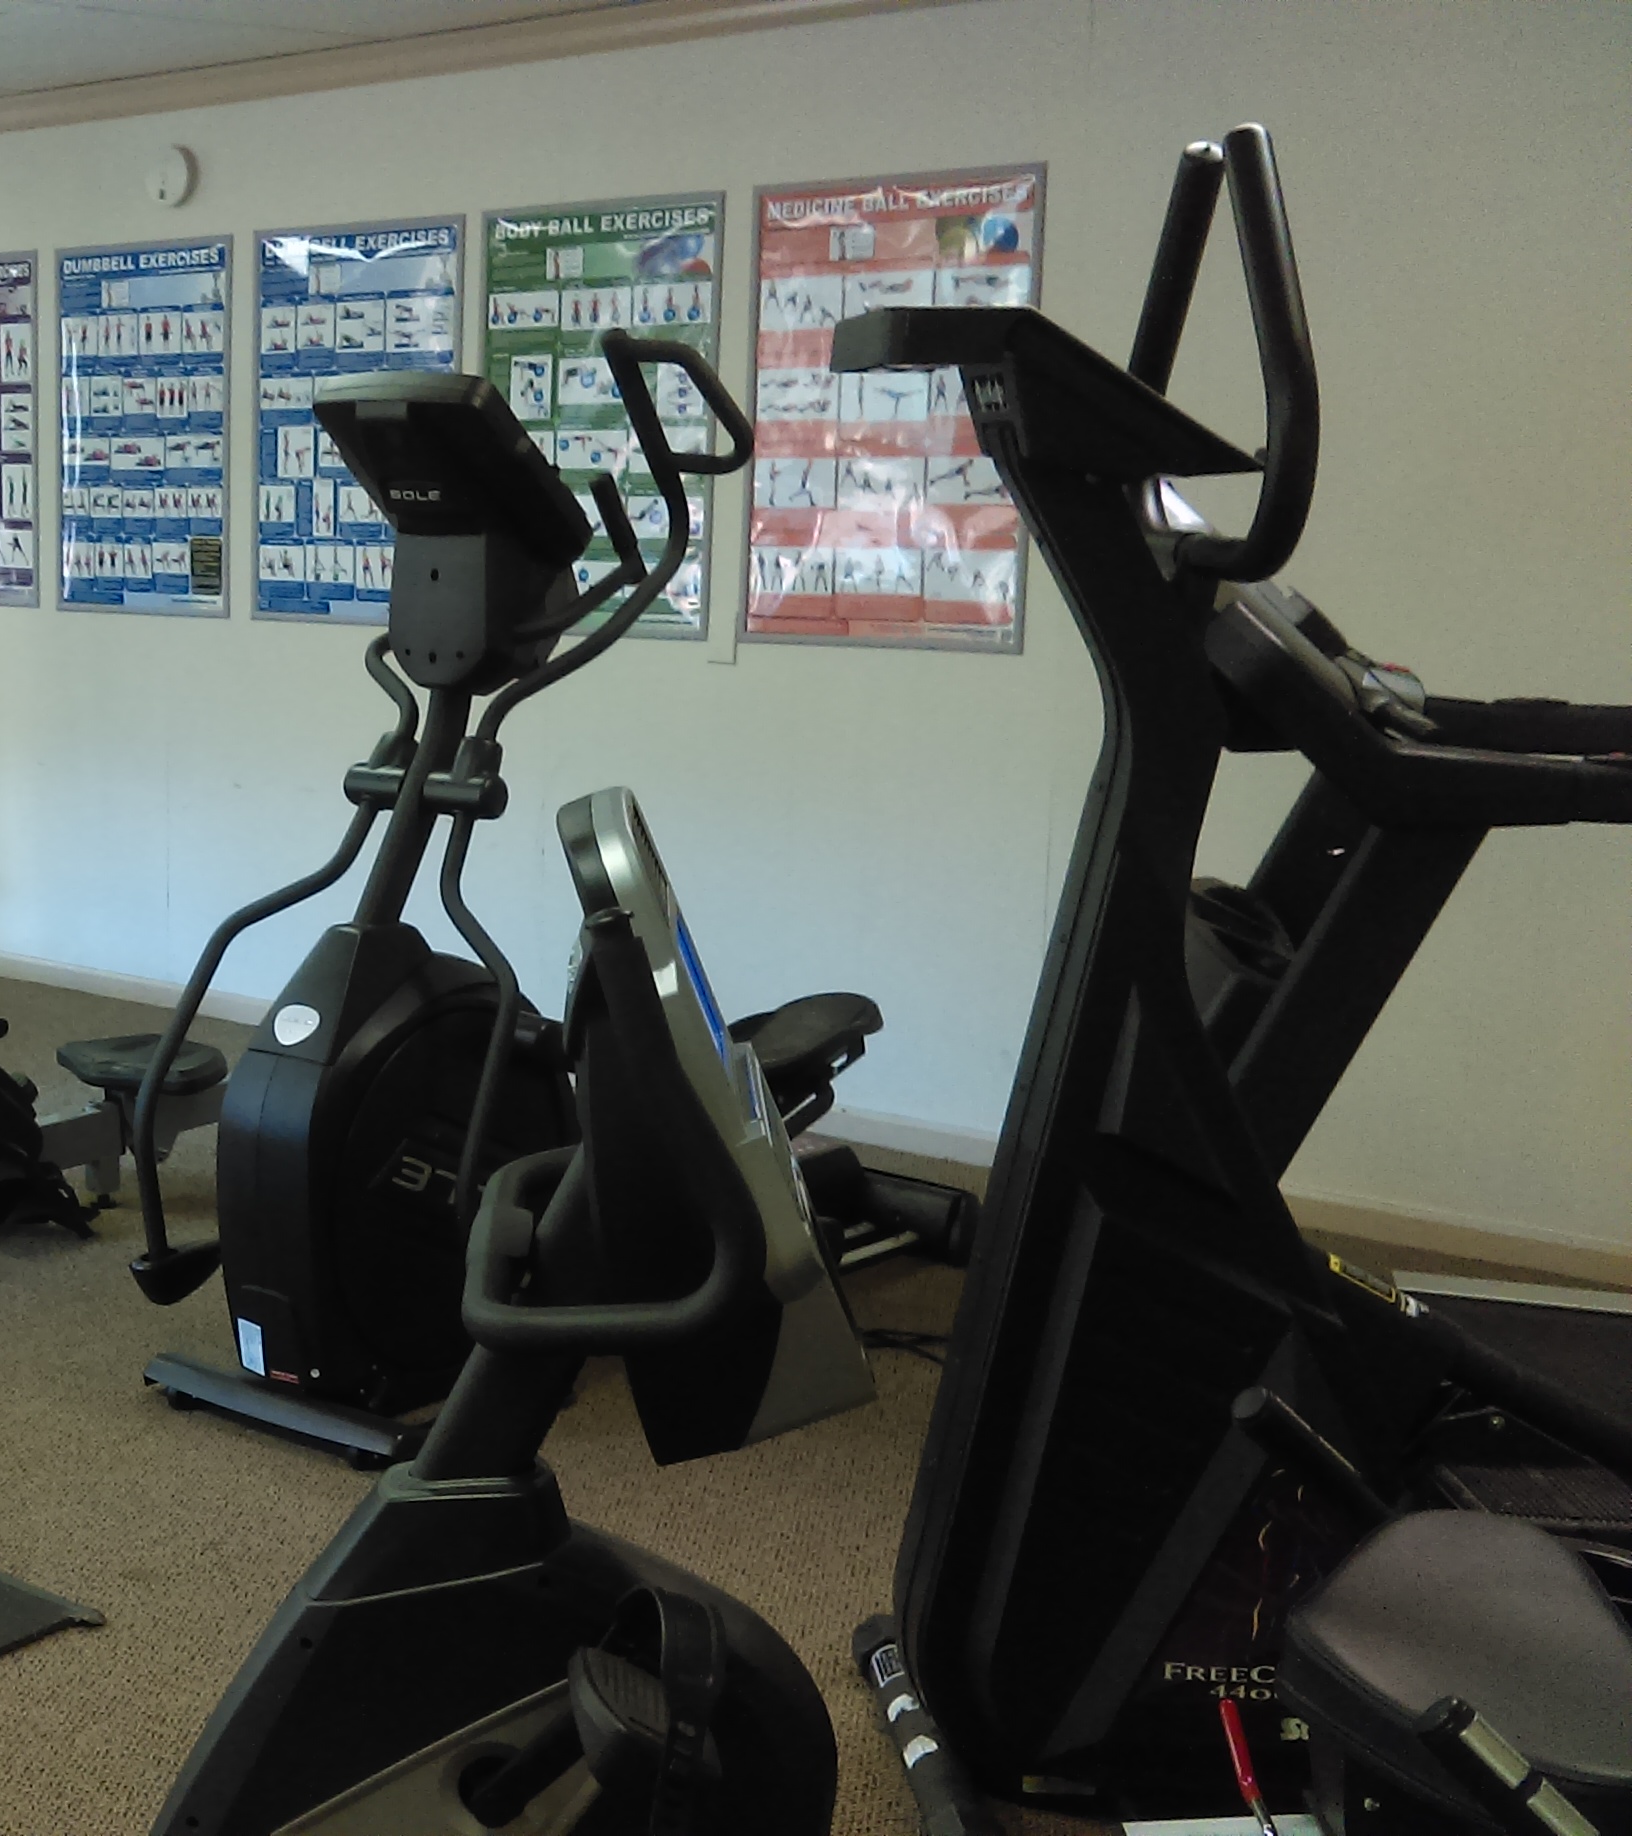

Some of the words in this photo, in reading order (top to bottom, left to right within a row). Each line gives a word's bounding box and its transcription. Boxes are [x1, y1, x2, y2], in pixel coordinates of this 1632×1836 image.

[768, 196, 855, 220] MEDICINE
[862, 191, 909, 212] BALL
[495, 221, 542, 240] BODY
[548, 216, 594, 236] BALL
[600, 207, 710, 232] EXERCISES
[355, 228, 450, 251] EXERCISES
[62, 255, 136, 275] DUMBBELL
[138, 248, 220, 269] EXERCISES
[389, 489, 441, 501] SOLE
[1163, 1661, 1276, 1683] FREEC
[1209, 1684, 1278, 1700] 440
